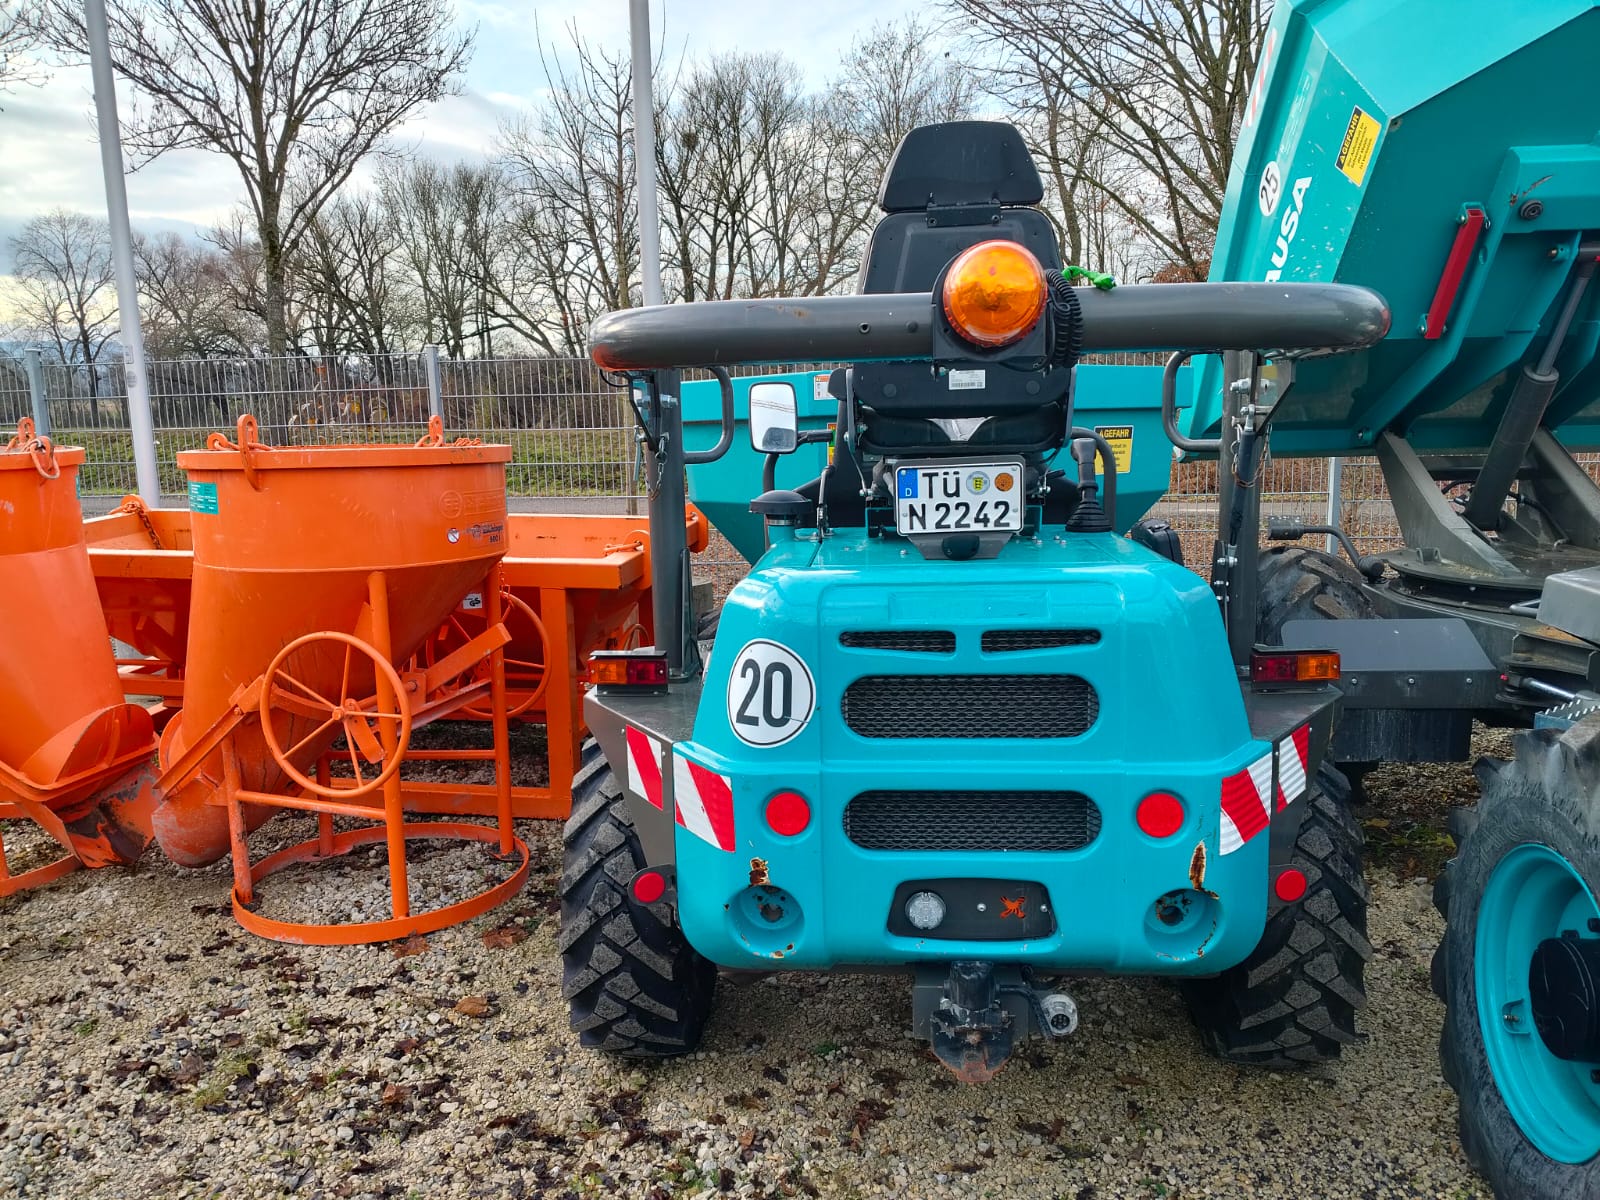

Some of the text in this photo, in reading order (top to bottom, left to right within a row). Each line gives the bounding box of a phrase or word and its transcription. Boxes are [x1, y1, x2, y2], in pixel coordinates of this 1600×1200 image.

[1342, 114, 1359, 154] GEFAHR
[1260, 167, 1279, 213] 25
[1103, 428, 1130, 438] GEFAHR
[905, 488, 912, 497] D
[922, 471, 960, 499] TÜ
[908, 500, 1010, 530] N 2242
[736, 658, 793, 728] 20
